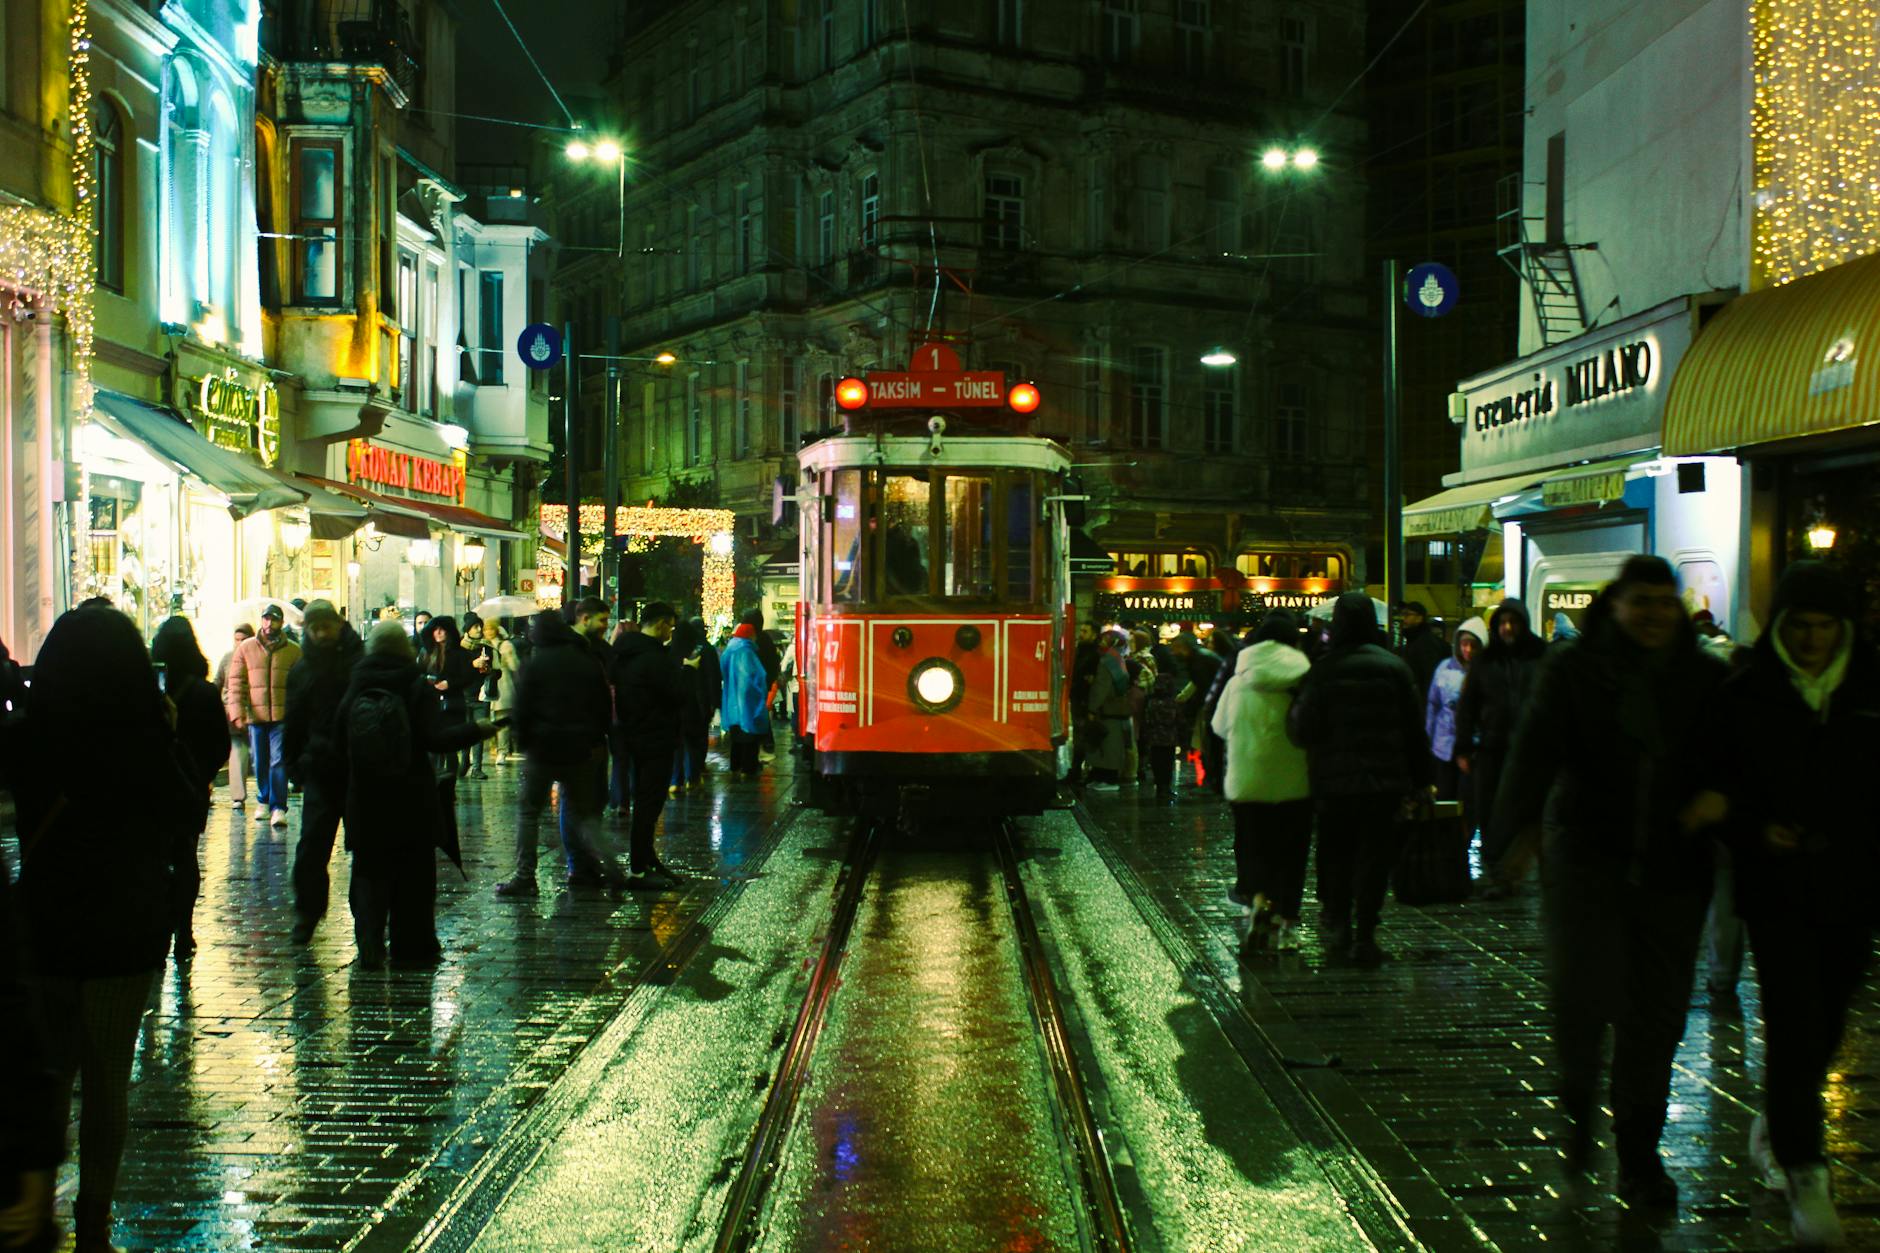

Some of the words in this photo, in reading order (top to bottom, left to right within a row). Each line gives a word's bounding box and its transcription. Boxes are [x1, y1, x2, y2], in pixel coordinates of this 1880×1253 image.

[931, 348, 940, 371] 1
[870, 377, 921, 399] TAKSİM
[954, 377, 999, 399] TÜNEL
[1475, 373, 1553, 432] cremeria
[1565, 341, 1652, 407] MILANO
[360, 442, 409, 489] KONAK
[412, 456, 460, 498] KEBAP
[1124, 597, 1194, 609] VITAVIEN
[1548, 593, 1593, 609] SALEP
[824, 641, 840, 663] 47
[1034, 640, 1046, 661] 47
